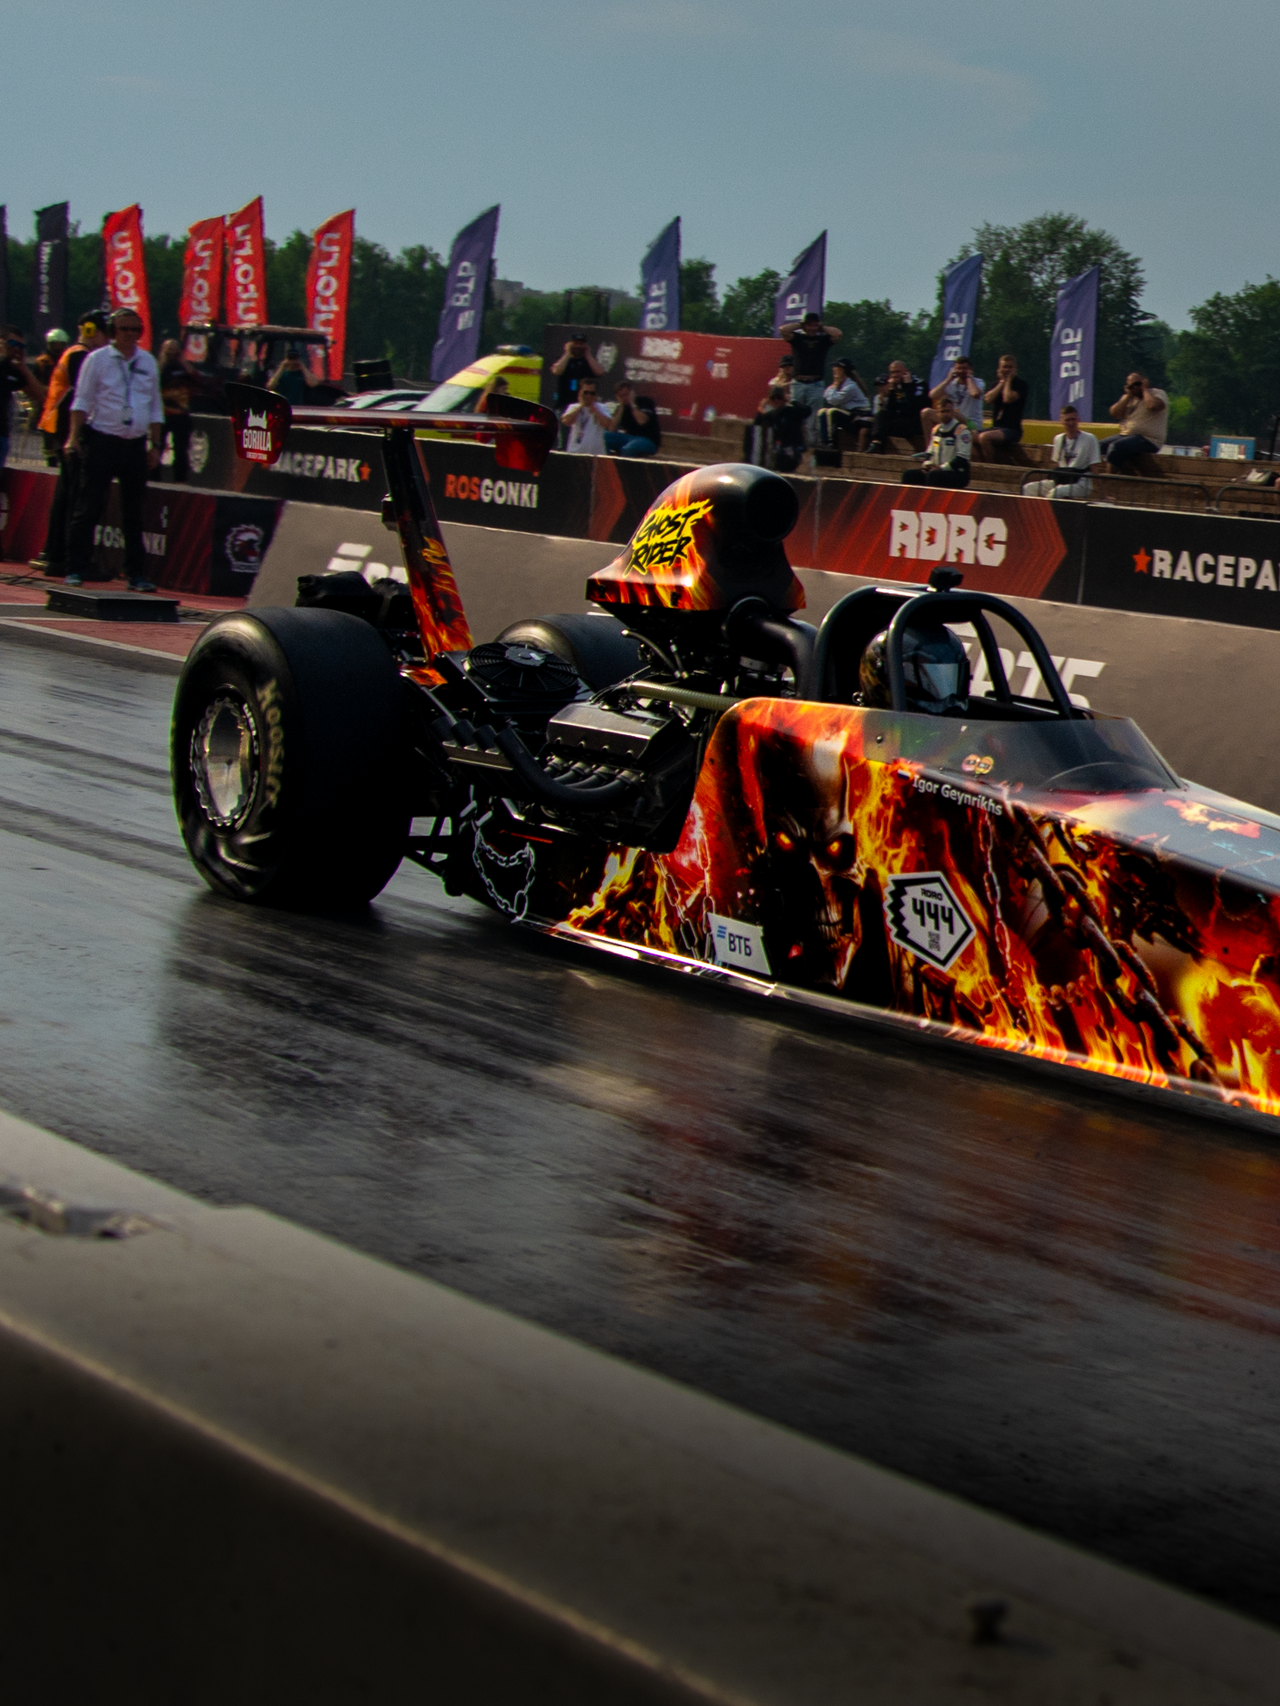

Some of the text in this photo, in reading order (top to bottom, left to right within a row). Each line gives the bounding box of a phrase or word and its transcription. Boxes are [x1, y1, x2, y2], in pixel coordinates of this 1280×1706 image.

[243, 429, 272, 452] GORILLA
[270, 451, 362, 483] ACEPARK
[444, 474, 539, 509] ROSGONKI
[635, 508, 700, 542] GHOST
[626, 536, 692, 576] RIDER
[913, 774, 1003, 816] Igor Geynrikhs
[912, 898, 954, 935] 444
[728, 932, 752, 957] ВТБ
